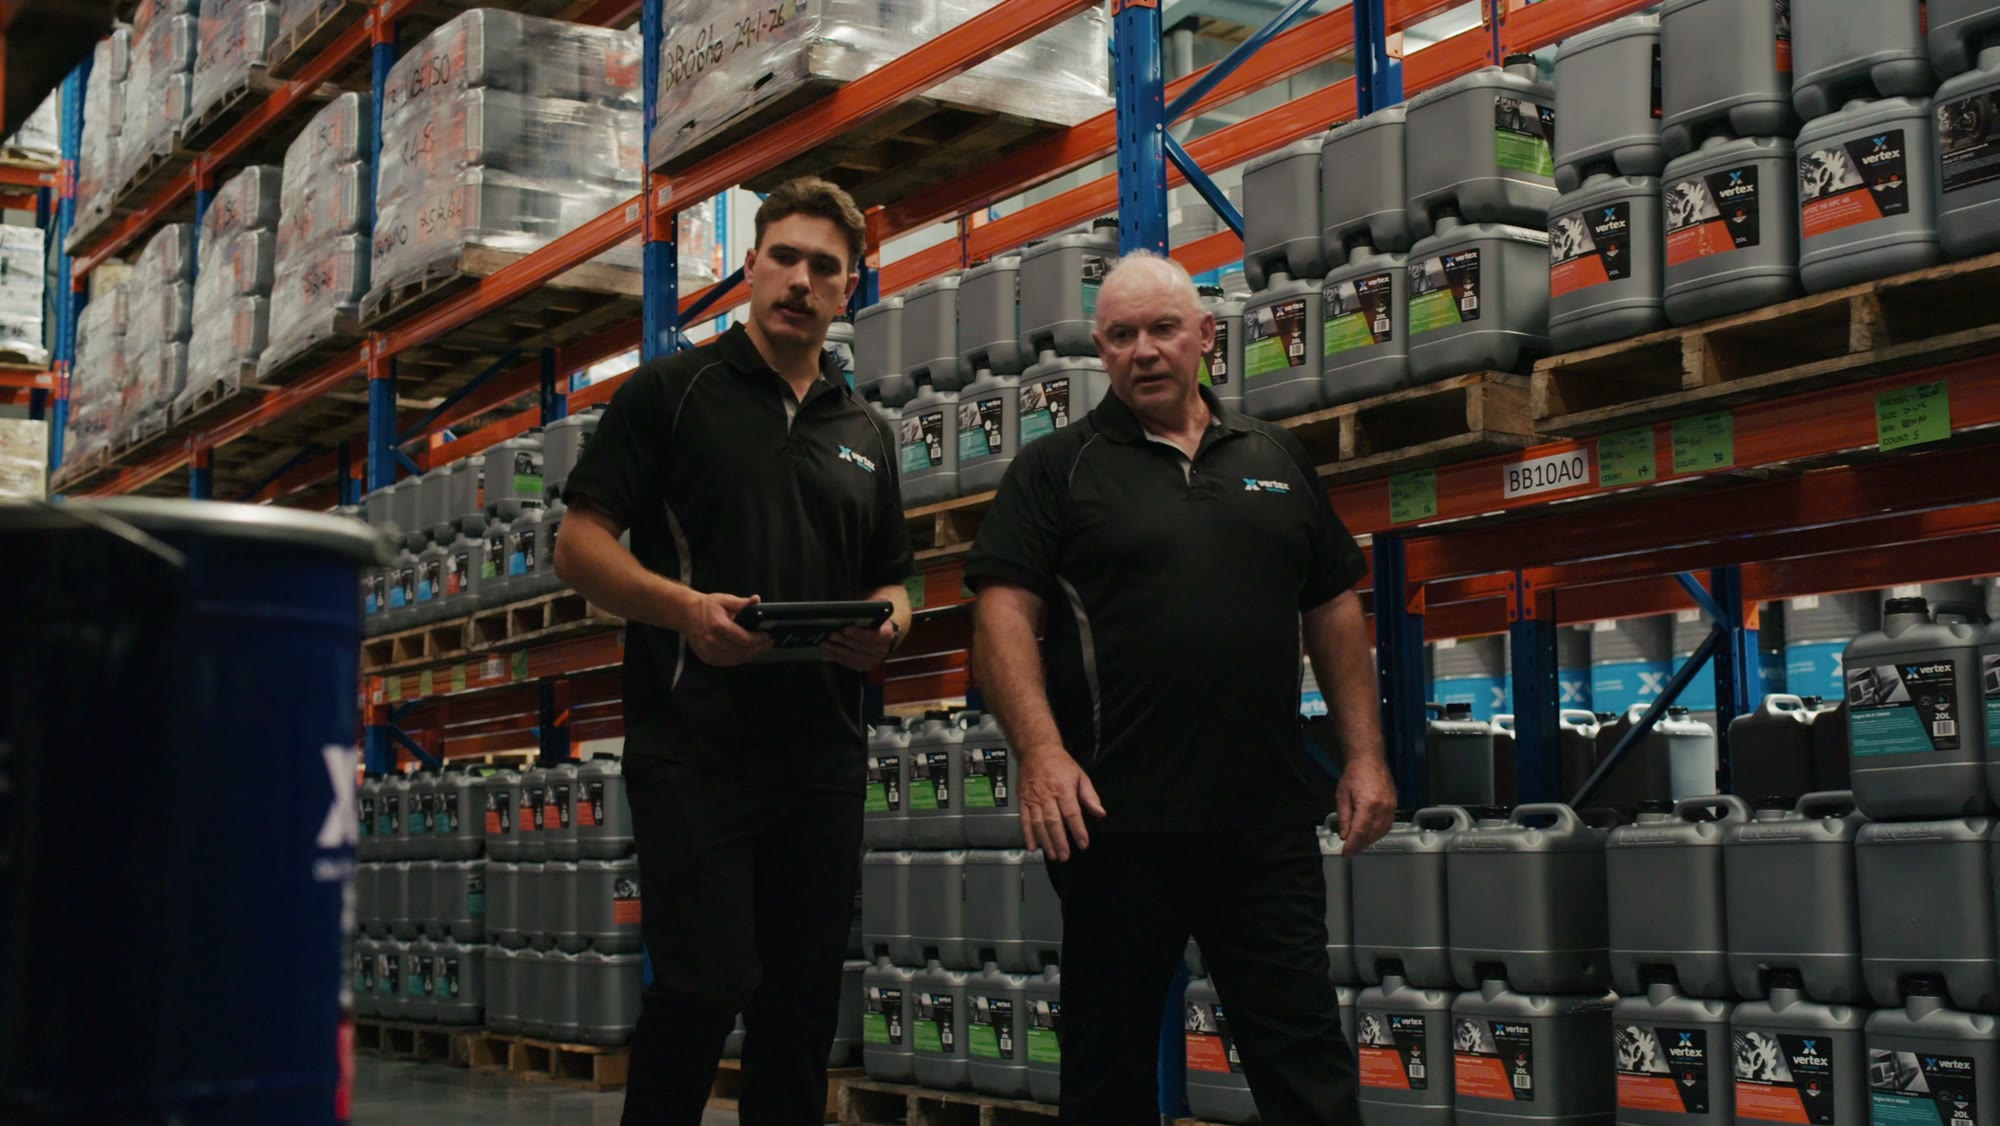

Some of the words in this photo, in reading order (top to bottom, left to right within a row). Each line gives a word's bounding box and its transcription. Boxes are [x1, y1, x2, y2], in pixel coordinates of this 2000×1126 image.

[1862, 149, 1900, 165] vertex
[1719, 184, 1754, 198] vertex
[1595, 220, 1626, 233] vertex
[1455, 252, 1478, 262] vertex
[1368, 276, 1390, 286] vertex
[1284, 303, 1304, 312] vertex
[1509, 457, 1584, 493] BB10A0
[1257, 480, 1290, 490] vertex
[1920, 664, 1951, 674] vertex
[1935, 712, 1951, 720] 20L
[1401, 1018, 1423, 1026] vertex
[1505, 1026, 1529, 1034] vertex
[1669, 1048, 1703, 1058] vertex
[1792, 1056, 1828, 1067] vertex
[1938, 1060, 1971, 1070] vertex
[1954, 1110, 1970, 1119] 20L
